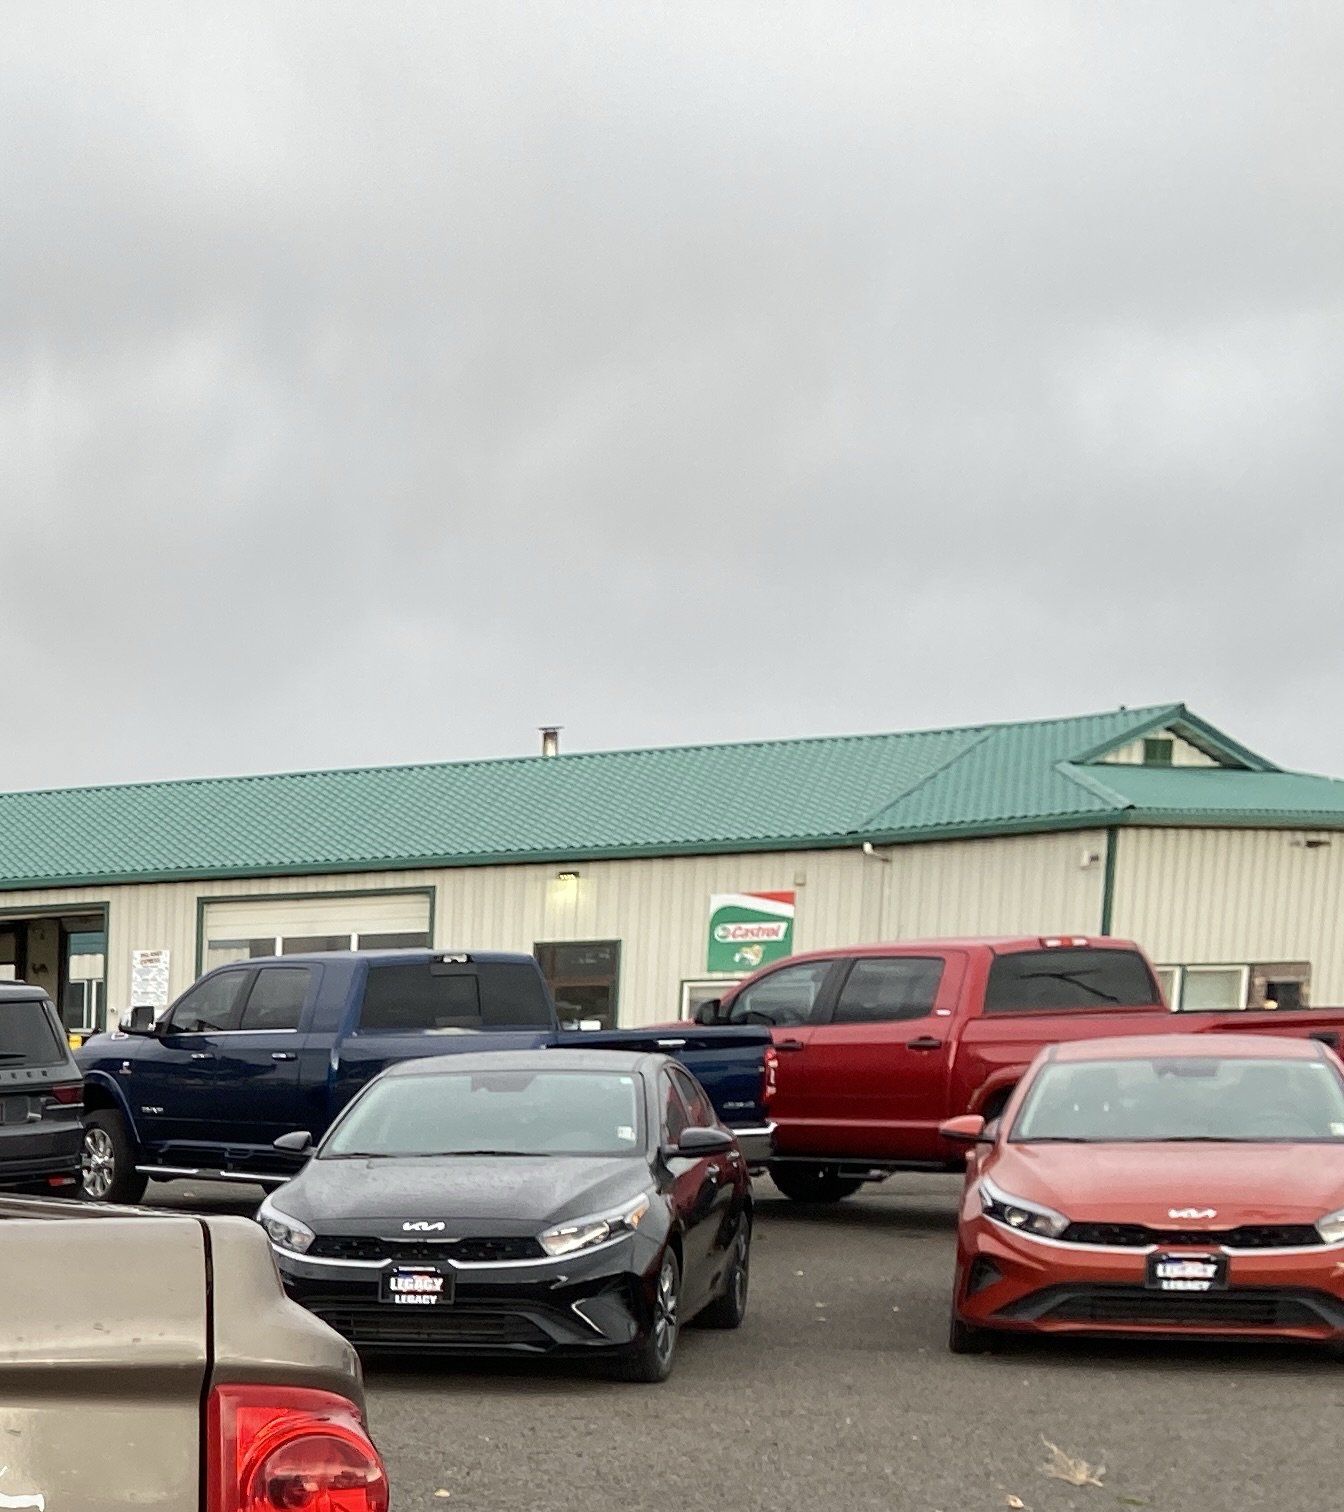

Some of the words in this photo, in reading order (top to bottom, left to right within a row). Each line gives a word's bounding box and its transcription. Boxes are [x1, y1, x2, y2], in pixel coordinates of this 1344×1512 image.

[731, 925, 781, 938] Castrol
[390, 1277, 443, 1291] LEGACY
[394, 1294, 437, 1304] LEGACY
